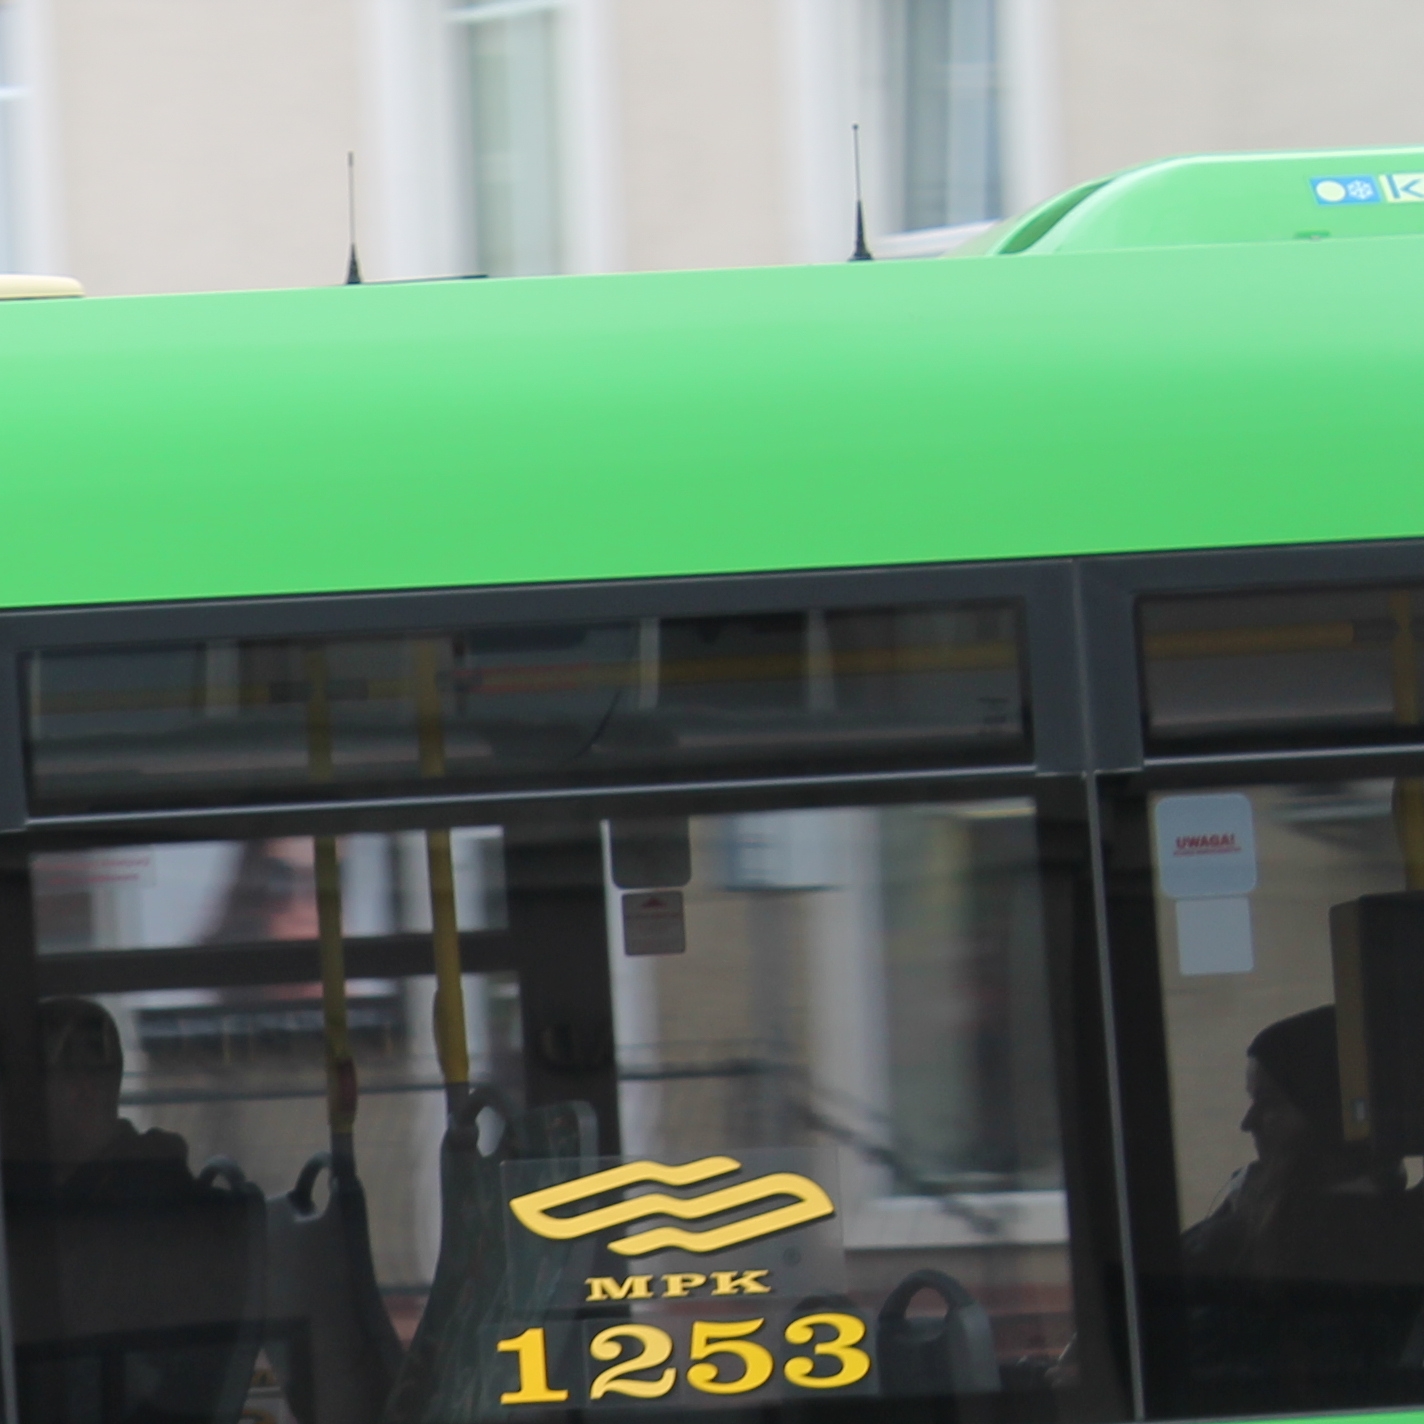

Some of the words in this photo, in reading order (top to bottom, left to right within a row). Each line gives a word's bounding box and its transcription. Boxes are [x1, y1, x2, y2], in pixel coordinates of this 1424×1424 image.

[1175, 832, 1236, 849] UWAGA!
[585, 1268, 772, 1303] MPK
[496, 1312, 872, 1406] 1253
